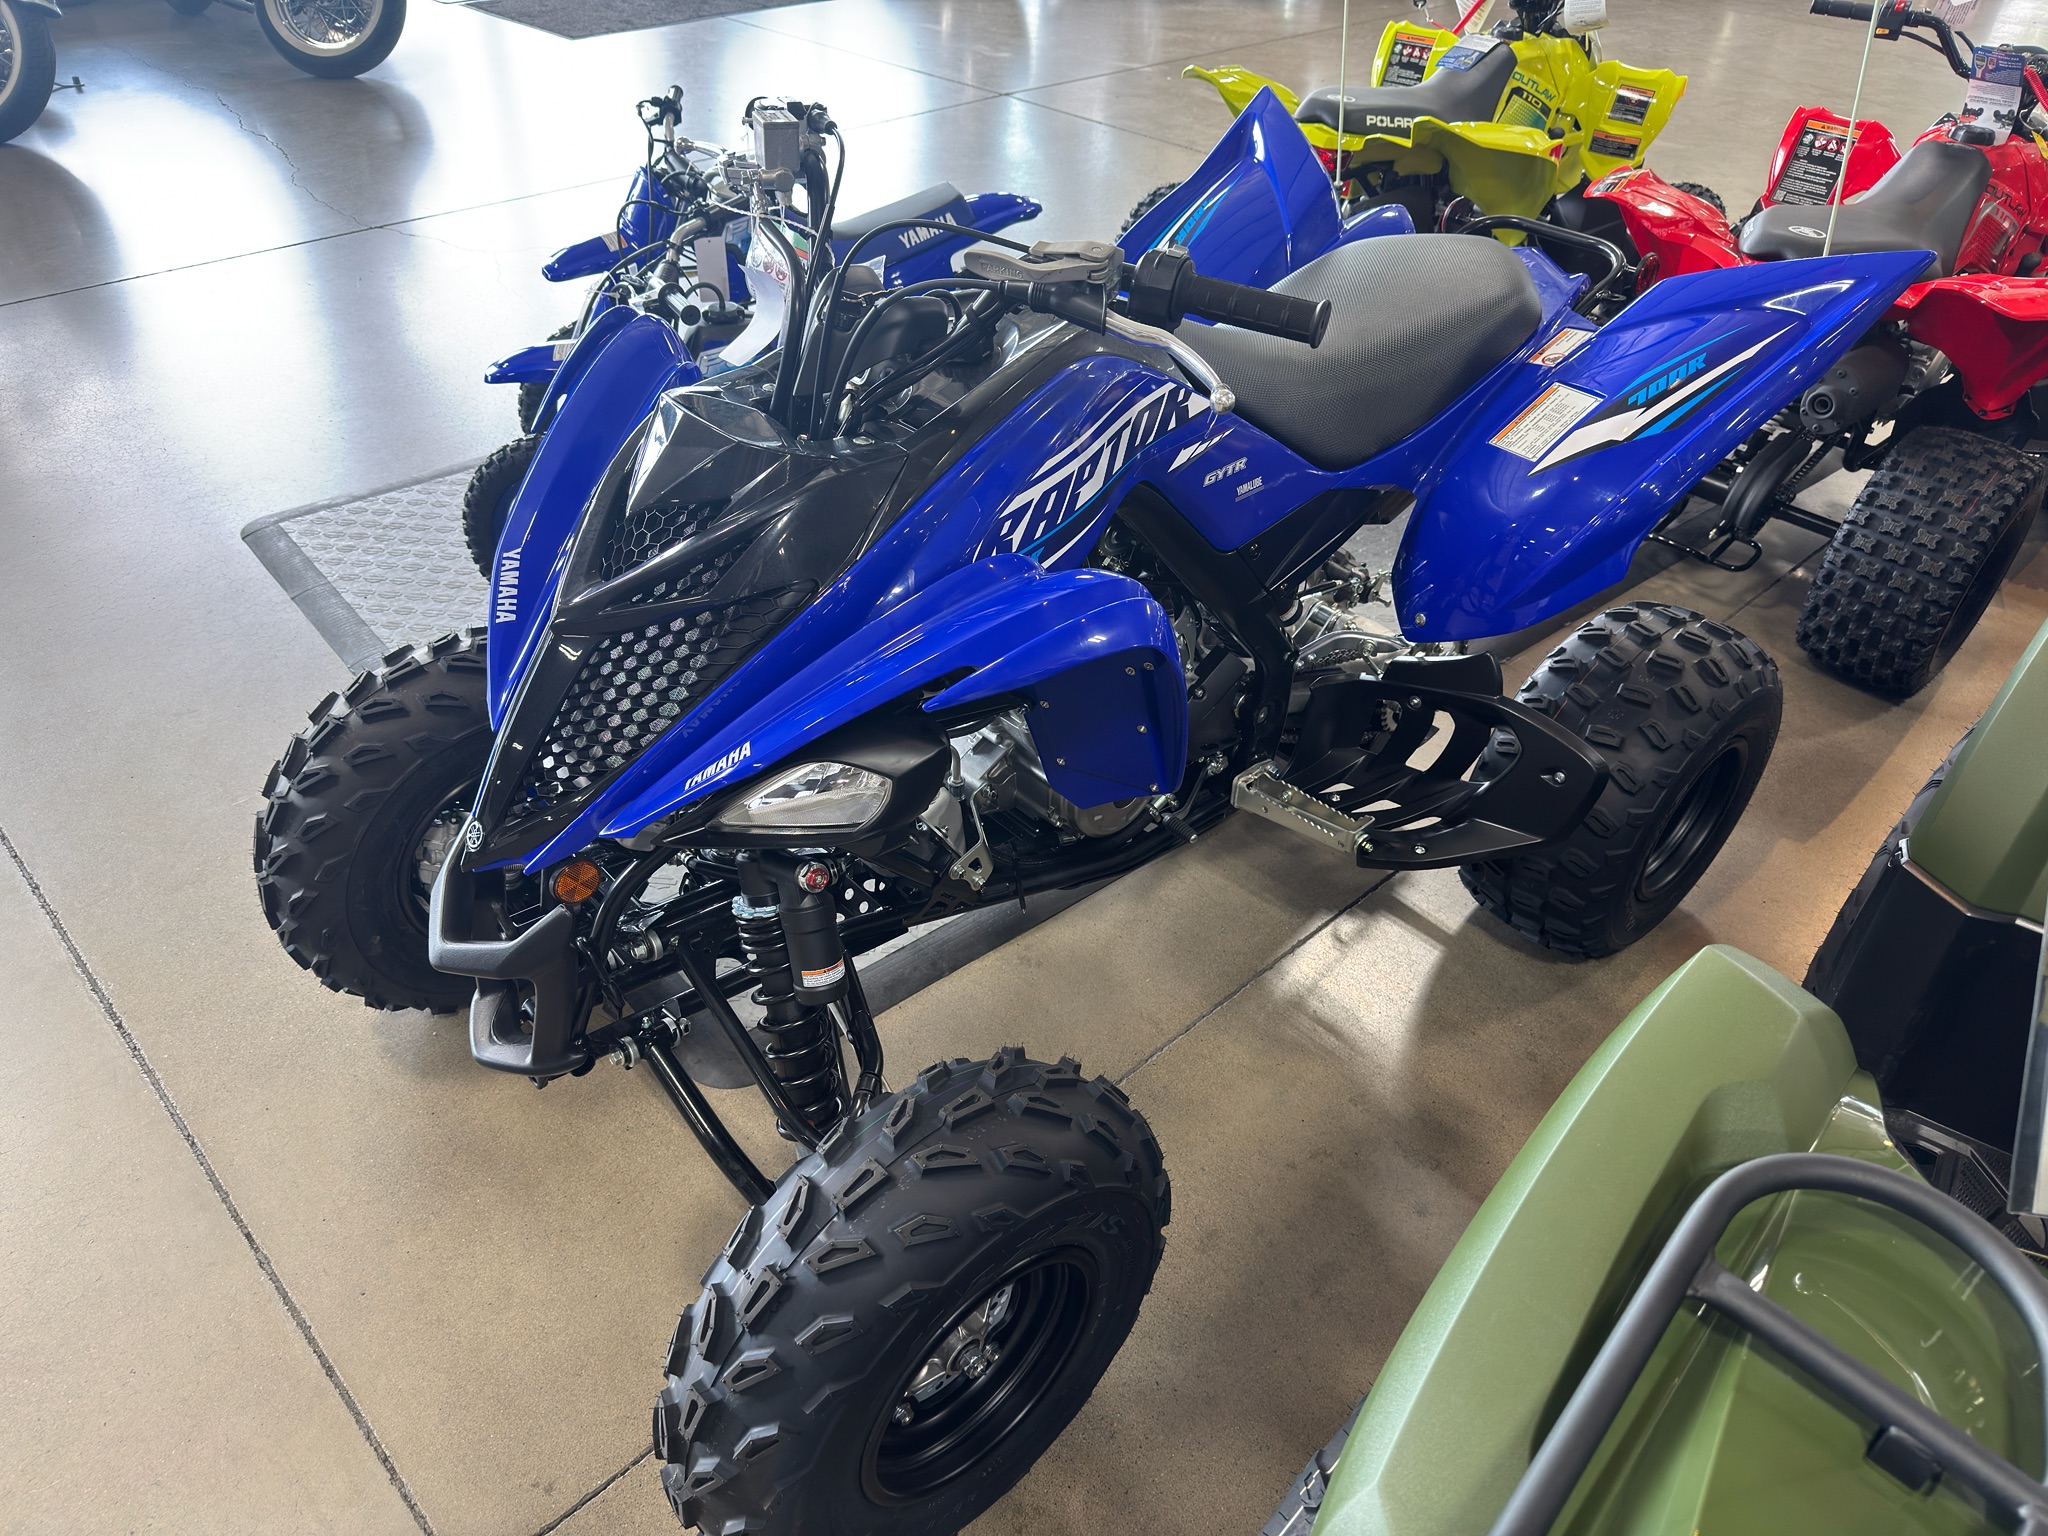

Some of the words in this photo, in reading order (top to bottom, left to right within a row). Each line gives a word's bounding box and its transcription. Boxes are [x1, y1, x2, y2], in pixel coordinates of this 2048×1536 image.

[1512, 71, 1556, 102] OUTLAW
[1522, 90, 1542, 108] 110
[1366, 115, 1414, 128] POLAR
[1985, 184, 2028, 218] OUTLAW
[980, 262, 1024, 280] PARKING
[1627, 352, 1707, 407] 700R
[978, 384, 1192, 557] RAPTOR
[1203, 456, 1248, 487] GYTR
[1236, 476, 1263, 496] YAMALUBE
[495, 547, 522, 624] YAMAHA
[684, 740, 751, 791] YAMAHA
